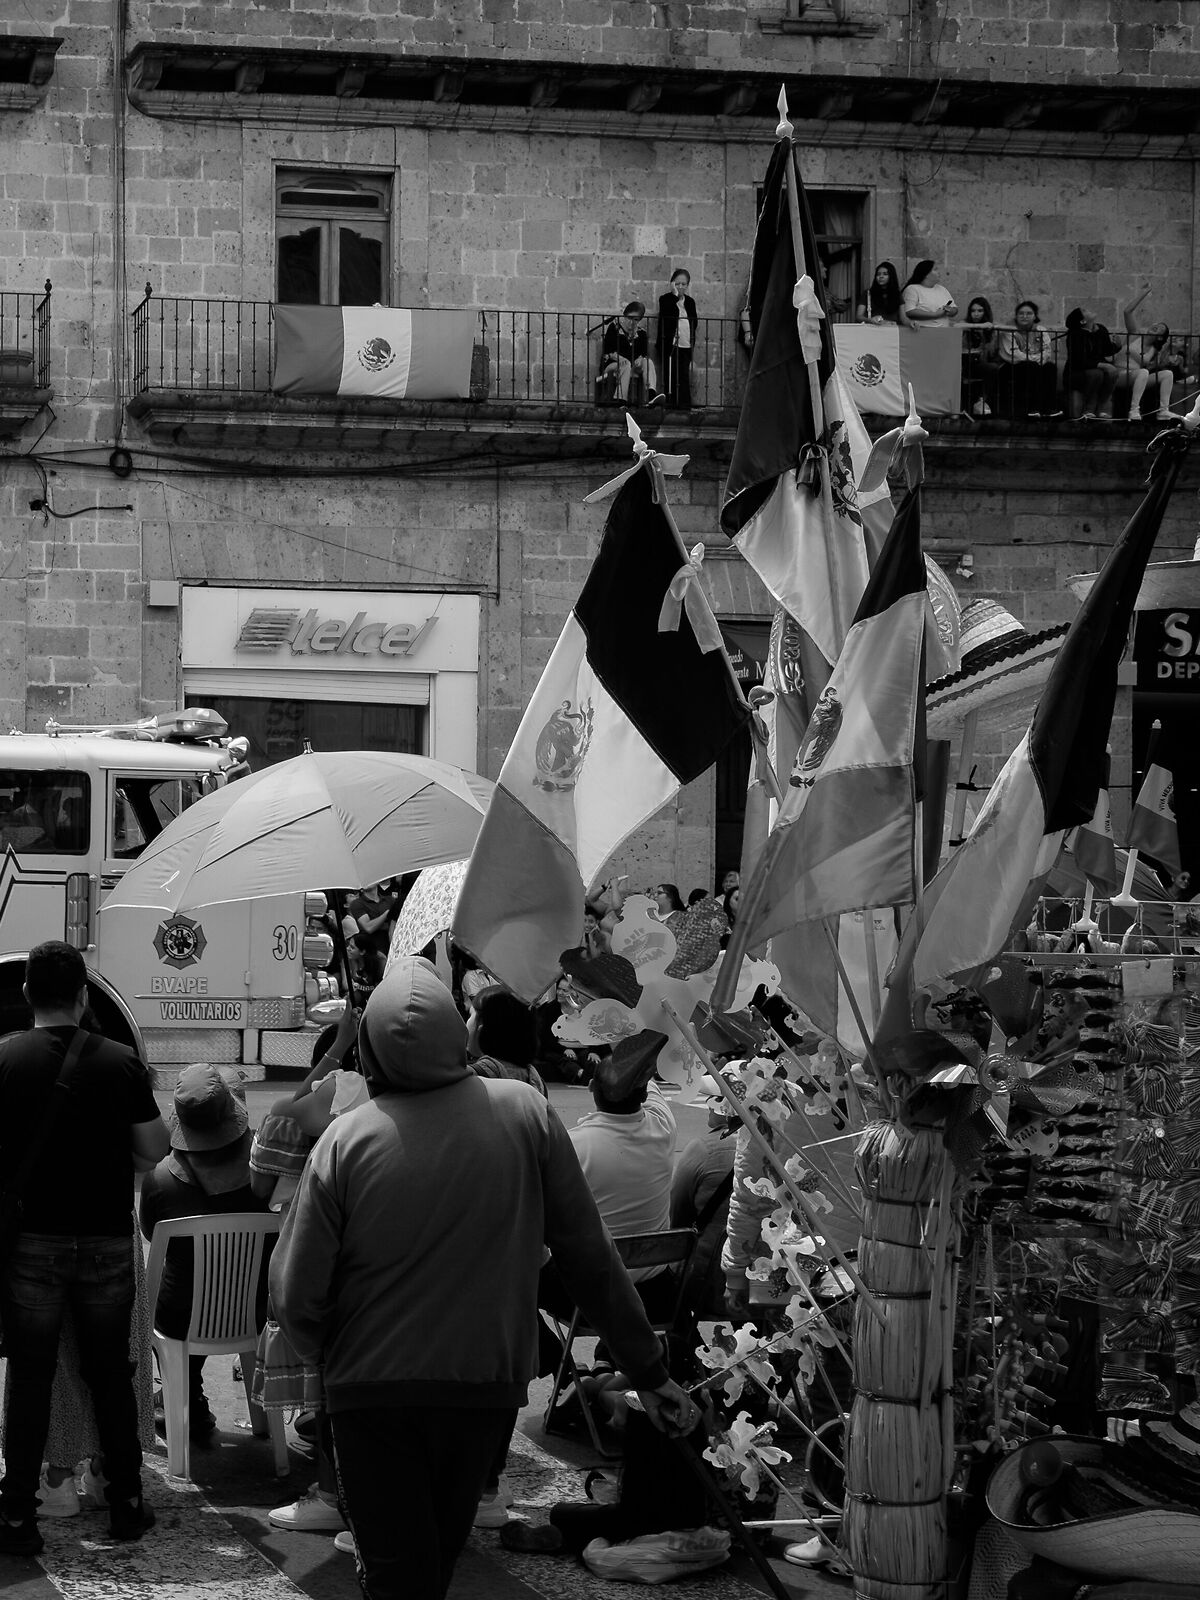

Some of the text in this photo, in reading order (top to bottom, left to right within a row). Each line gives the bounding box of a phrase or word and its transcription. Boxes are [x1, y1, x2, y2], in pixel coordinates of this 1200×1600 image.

[290, 608, 440, 656] telcel
[1163, 612, 1200, 657] S
[272, 925, 298, 960] 30
[152, 976, 208, 994] BVAPE
[160, 1002, 242, 1021] VOLUNTARIOS
